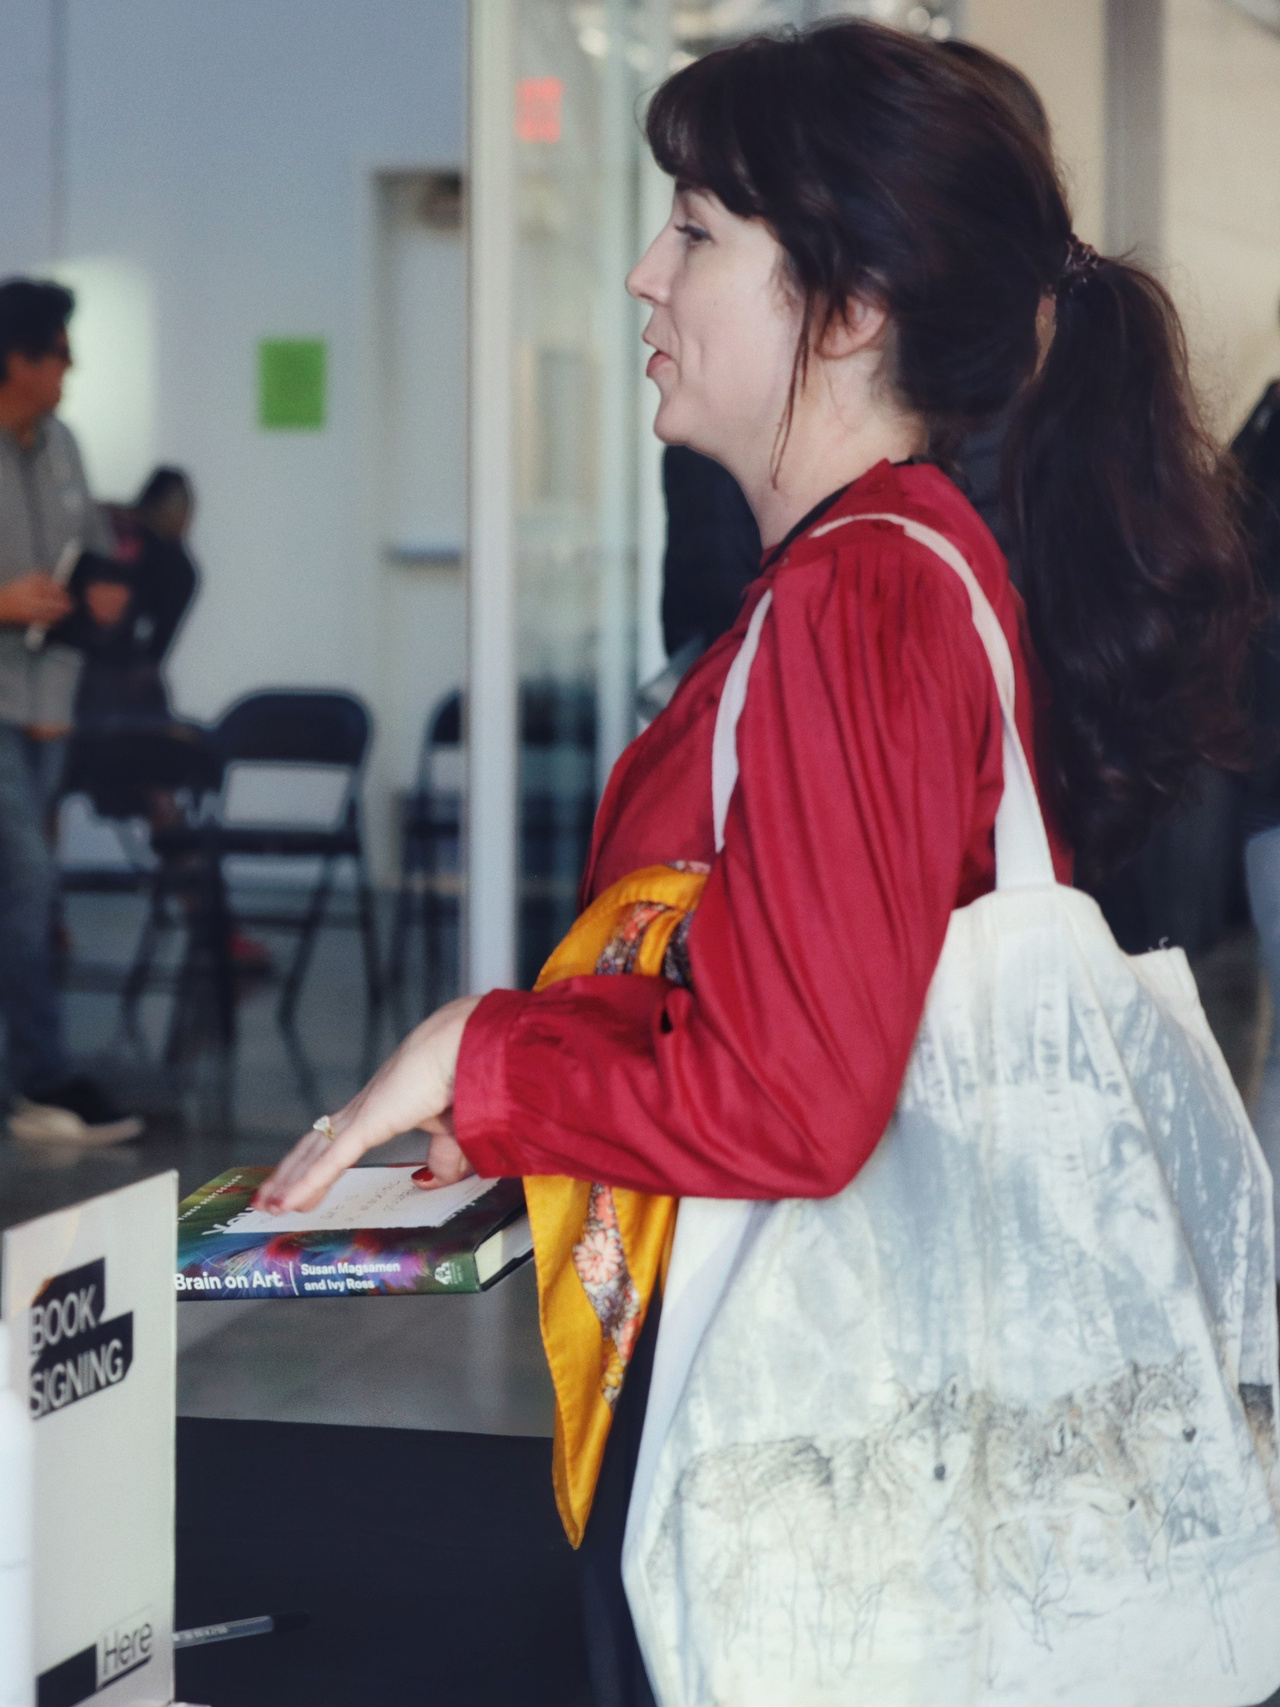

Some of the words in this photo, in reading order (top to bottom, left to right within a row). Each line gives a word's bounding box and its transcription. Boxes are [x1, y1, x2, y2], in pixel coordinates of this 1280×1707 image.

[174, 1271, 222, 1290] Brain
[224, 1274, 249, 1289] on
[252, 1270, 284, 1288] Art
[300, 1263, 336, 1276] Susan
[337, 1262, 401, 1277] Magsamen
[304, 1279, 327, 1291] and
[328, 1278, 345, 1292] Ivy
[346, 1278, 375, 1290] Ross
[30, 1283, 97, 1354] BOOK
[29, 1338, 124, 1419] SIGNING
[103, 1622, 153, 1676] Here
